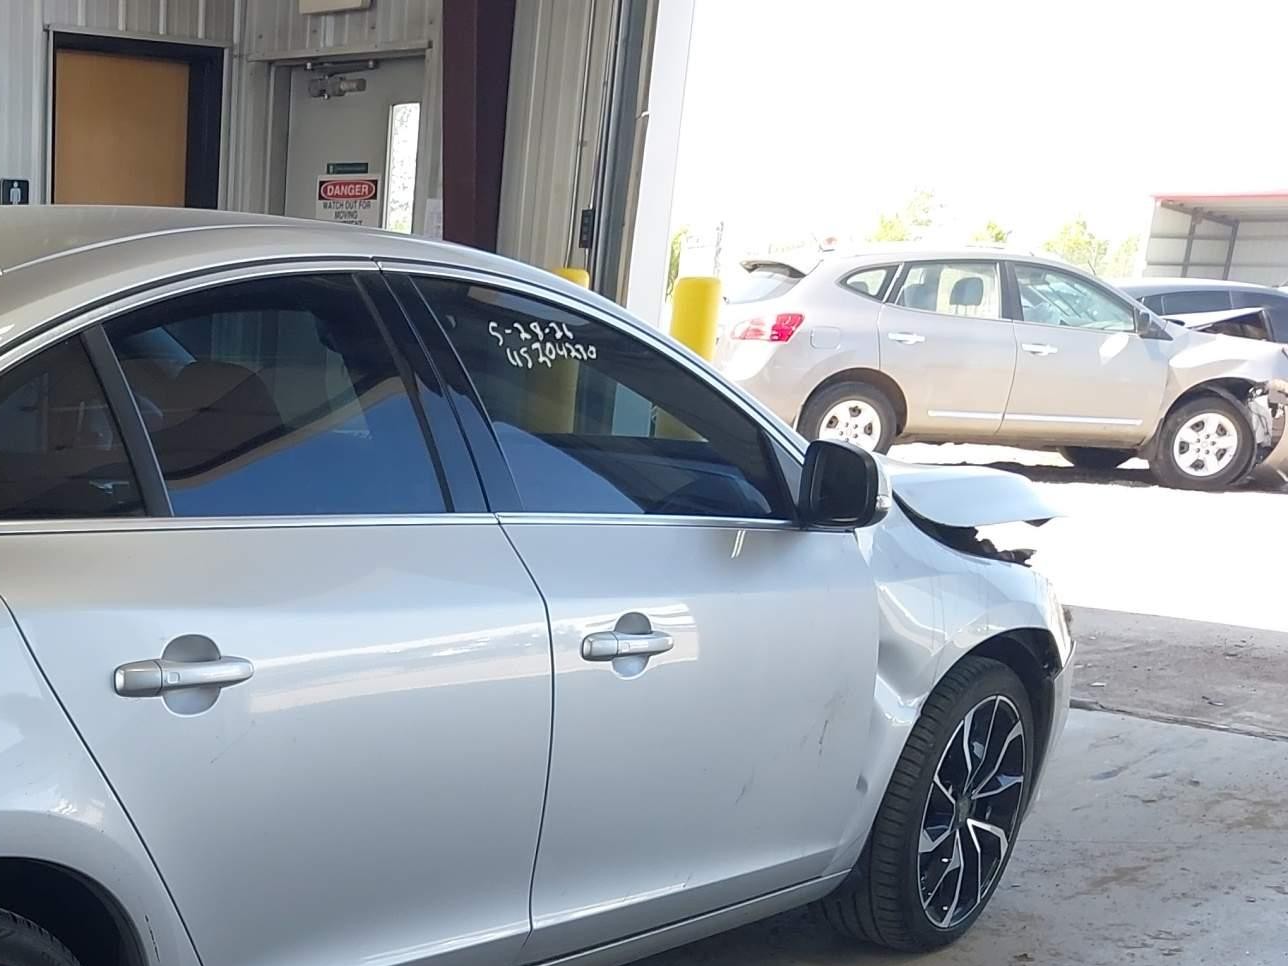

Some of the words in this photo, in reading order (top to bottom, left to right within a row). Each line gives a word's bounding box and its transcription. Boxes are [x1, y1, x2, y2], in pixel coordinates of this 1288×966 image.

[327, 184, 369, 196] DANGER
[323, 201, 344, 209] WATCH
[345, 200, 357, 209] OUT
[359, 200, 371, 209] FOR
[334, 211, 358, 219] MOVING
